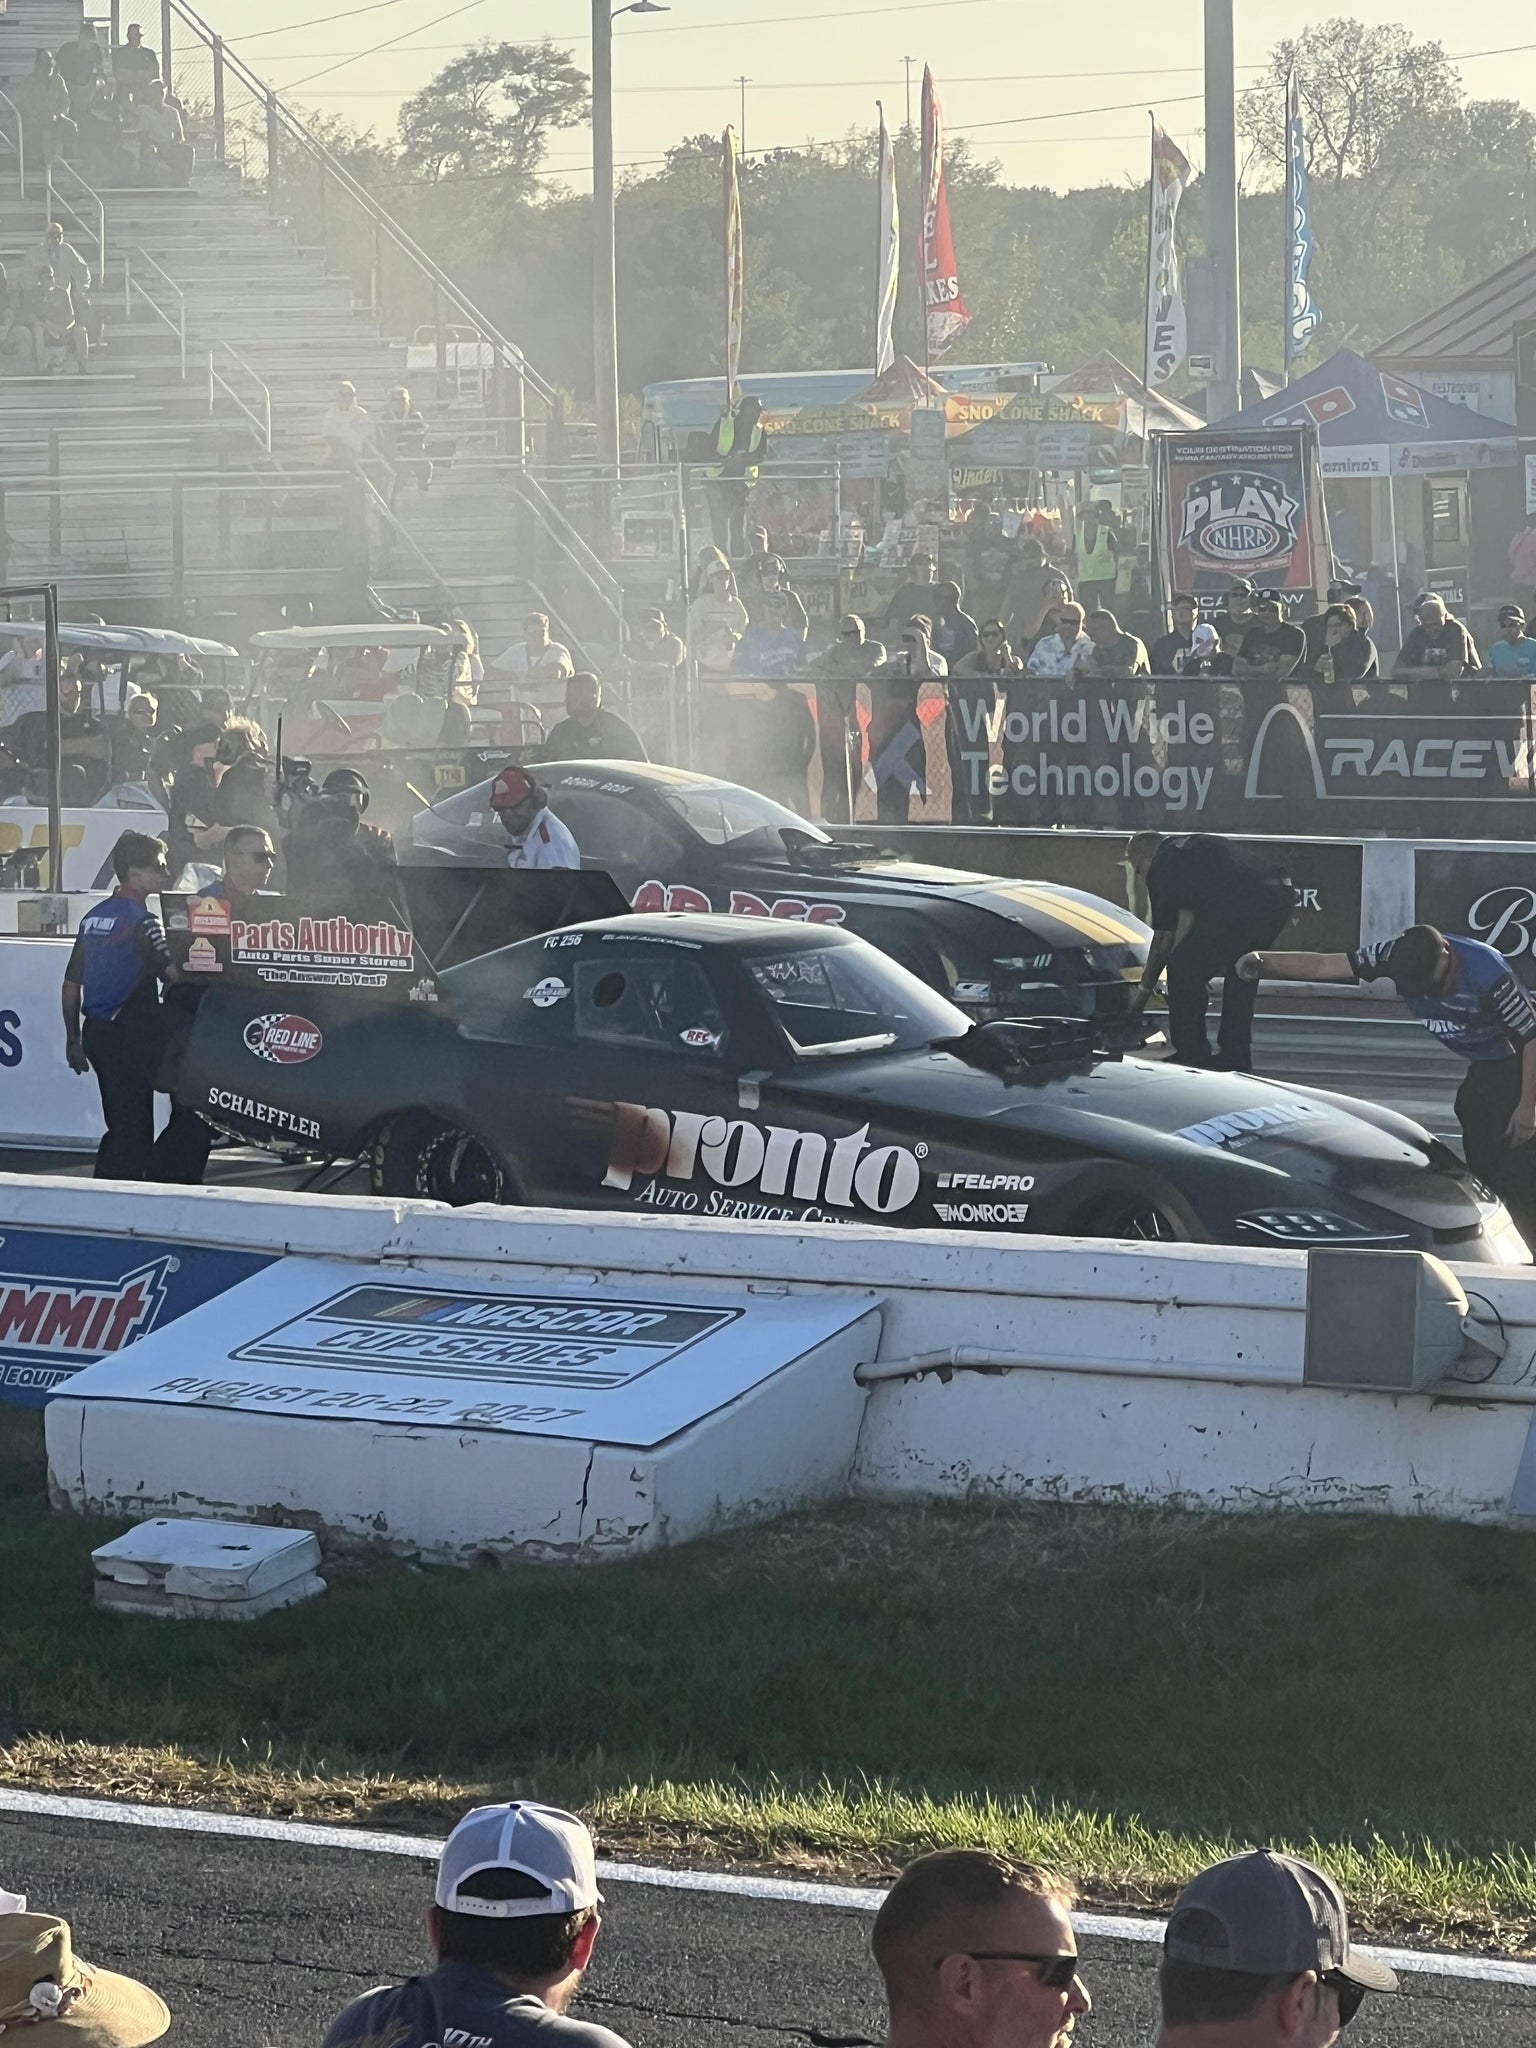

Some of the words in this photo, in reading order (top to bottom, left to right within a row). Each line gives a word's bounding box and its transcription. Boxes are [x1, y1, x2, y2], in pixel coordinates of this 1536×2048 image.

[803, 418, 844, 433] CONE
[849, 414, 900, 431] SHACK
[959, 405, 993, 421] SNO
[1001, 404, 1043, 421] CONE
[1048, 403, 1103, 421] SHACK
[1184, 486, 1293, 537] PLAY
[1214, 525, 1268, 549] NHRA
[959, 698, 1087, 743] World
[1100, 698, 1215, 744] Wide
[961, 750, 1214, 809] Technology
[230, 920, 295, 950] Parts
[299, 916, 413, 957] Authority
[544, 936, 558, 949] FC
[560, 934, 583, 947] 256
[238, 950, 270, 961] Auto
[273, 953, 310, 963] Parts
[314, 954, 355, 965] Super
[360, 956, 407, 967] Stores
[265, 1028, 290, 1045] RED
[290, 1030, 319, 1049] LINE
[687, 1030, 710, 1042] RFC
[208, 1087, 320, 1139] SCHAEFFLER
[952, 1172, 1035, 1191] FEL-PRO
[634, 1179, 699, 1211] AUTO
[703, 1190, 793, 1220] SERVICE
[946, 1203, 1020, 1223] MONROE
[437, 1302, 668, 1336] NASCAR
[317, 1328, 428, 1355] CUP
[424, 1335, 618, 1368] SERIES
[150, 1377, 319, 1404] AUGUST
